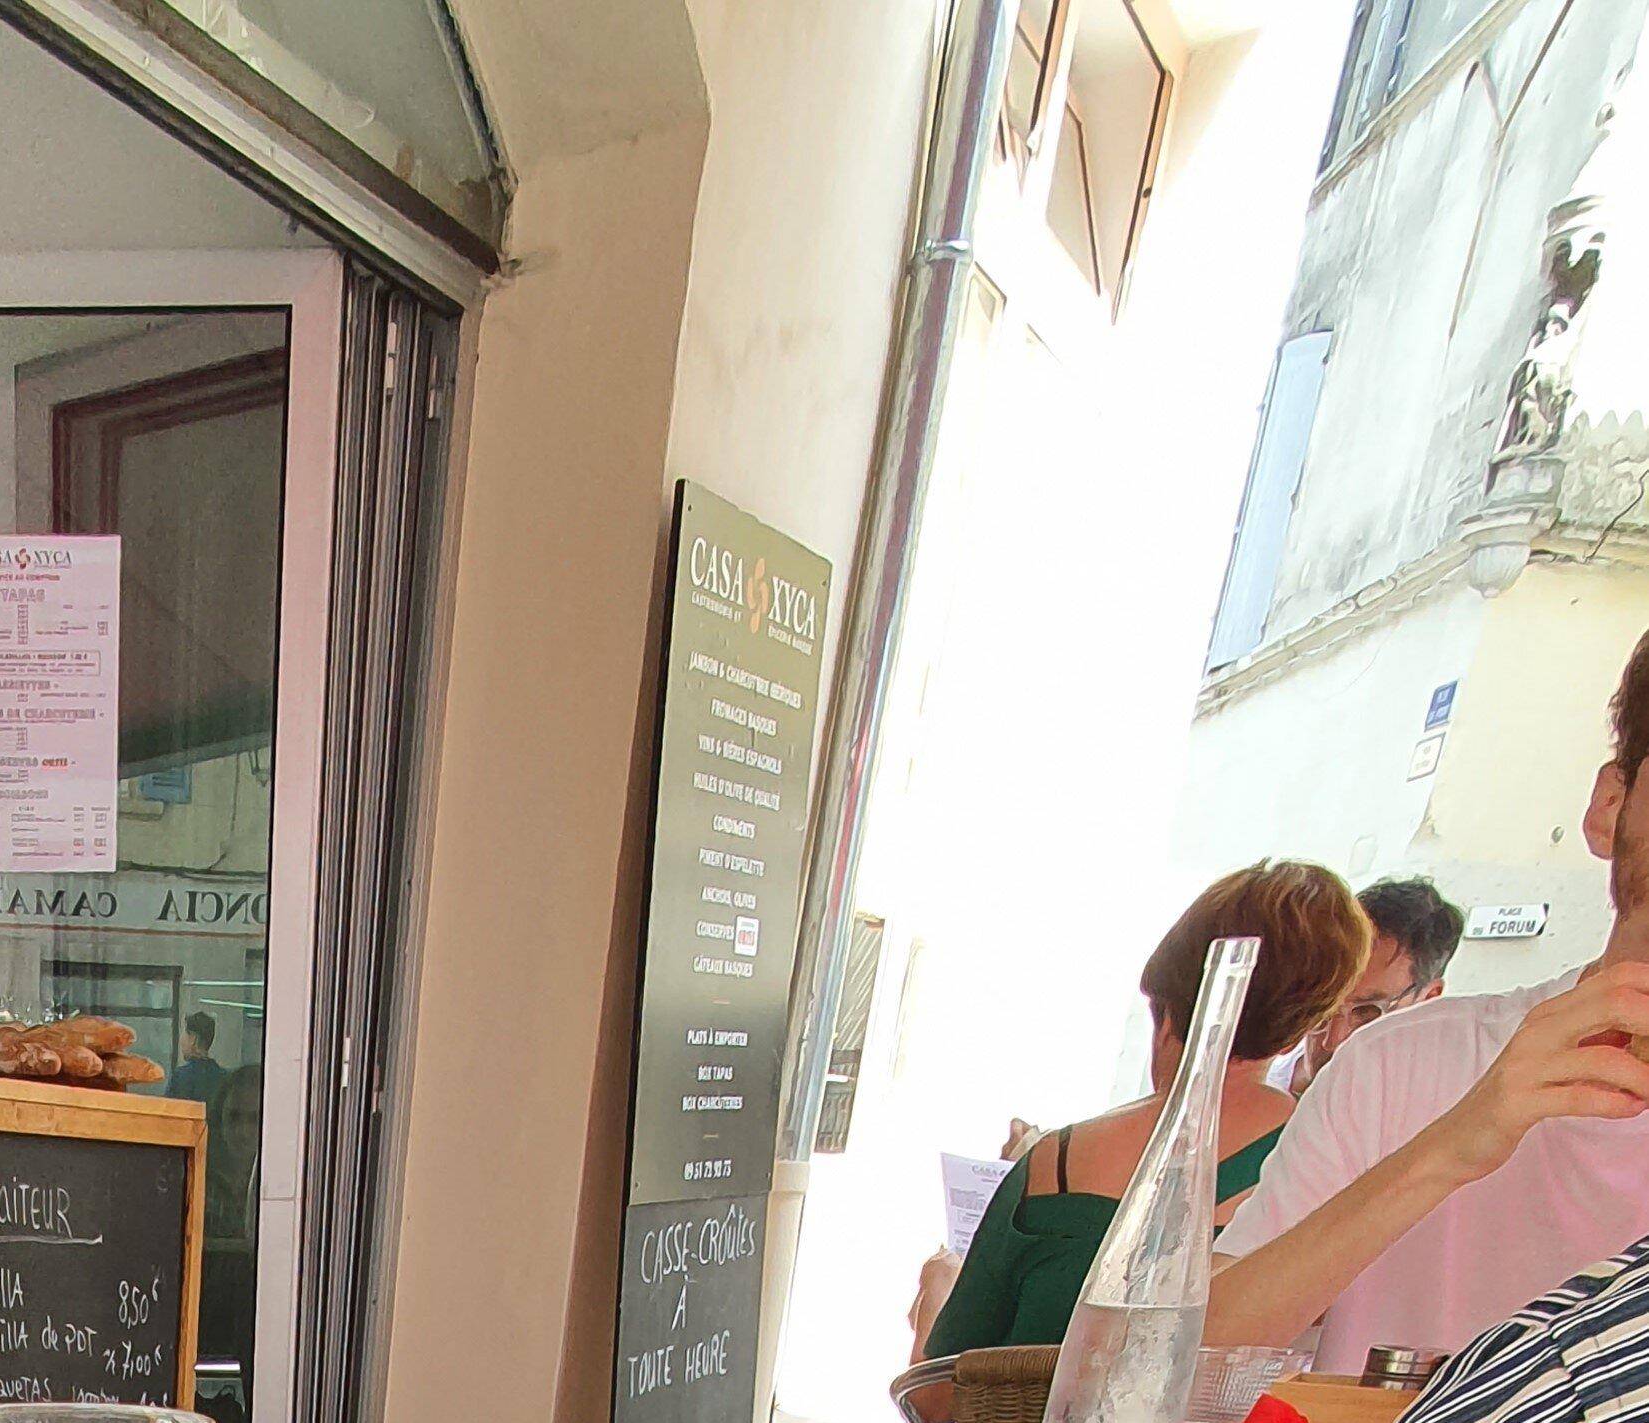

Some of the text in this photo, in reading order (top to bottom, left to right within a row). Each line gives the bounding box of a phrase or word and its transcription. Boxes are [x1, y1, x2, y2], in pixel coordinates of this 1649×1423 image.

[691, 537, 815, 640] CASA XYCA
[1489, 920, 1536, 934] FORUM
[687, 1029, 708, 1045] PLATS
[697, 1065, 734, 1082] BOX TAPAS
[682, 1096, 697, 1111] BOX
[42, 1315, 59, 1351] de
[65, 1323, 98, 1357] PDT
[628, 1329, 730, 1398] TOUTE HEURE
